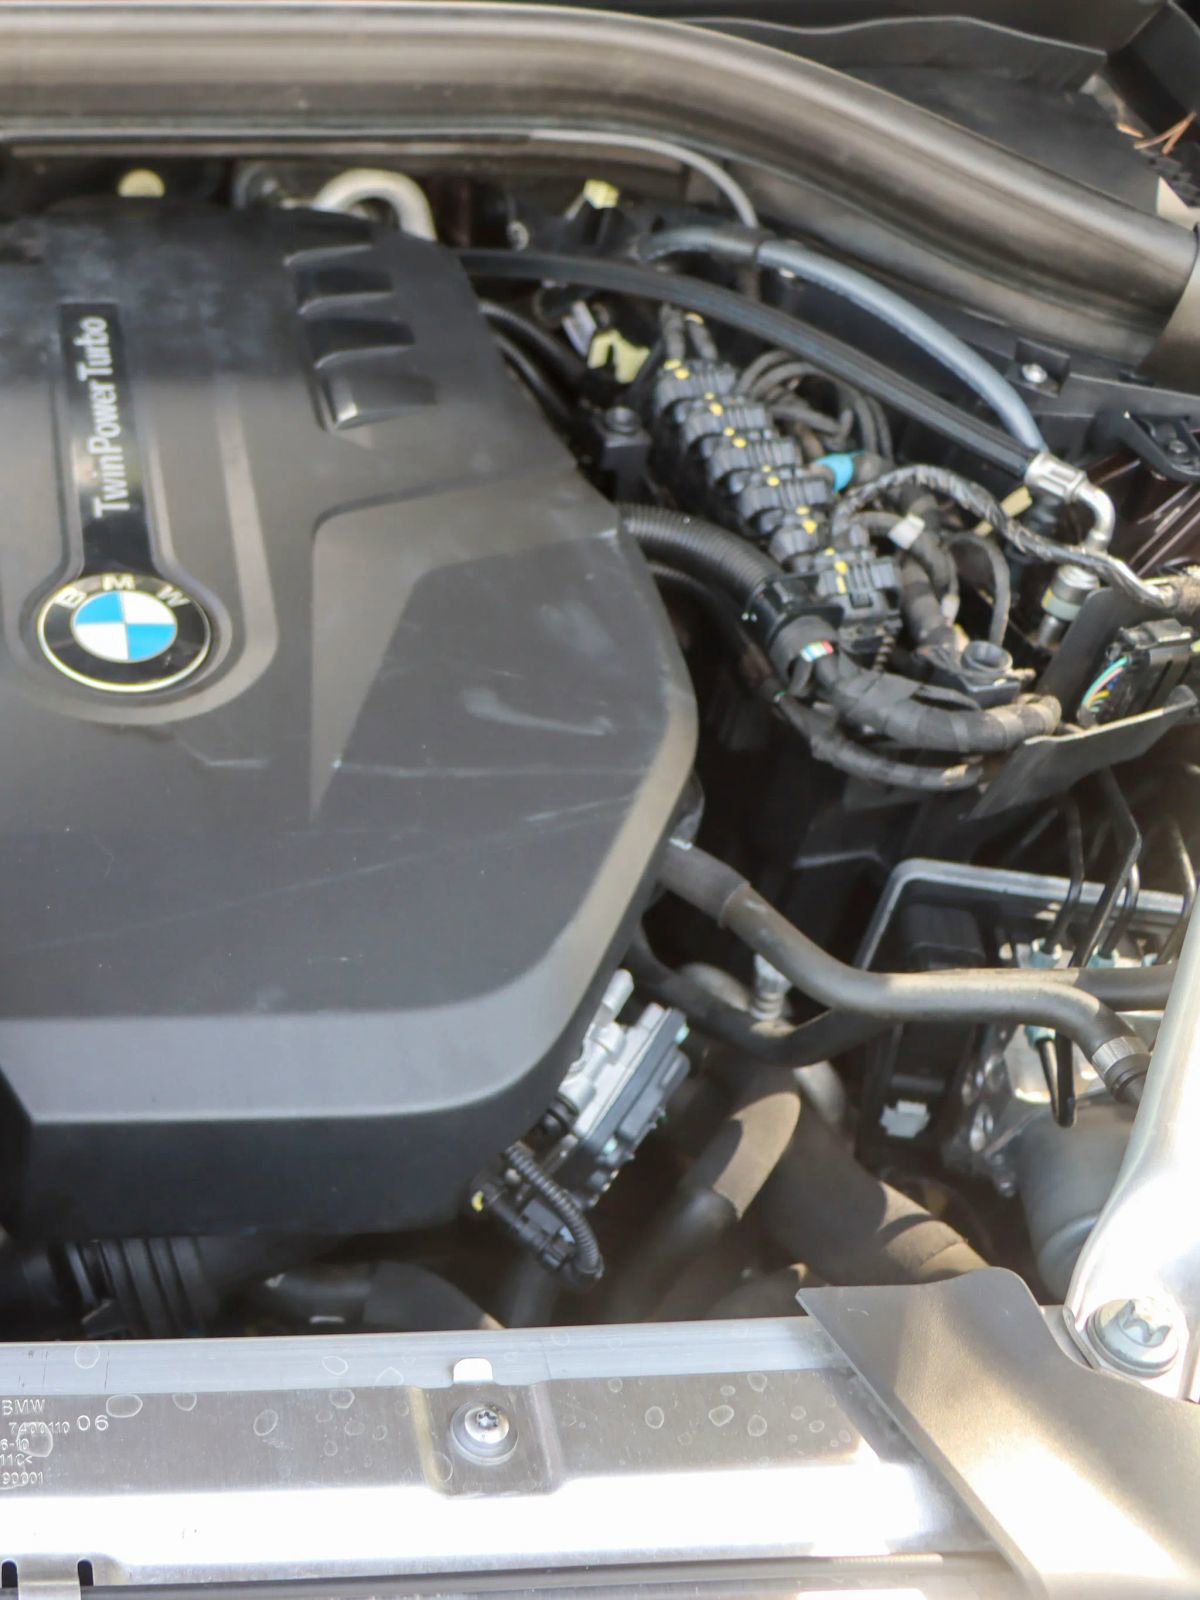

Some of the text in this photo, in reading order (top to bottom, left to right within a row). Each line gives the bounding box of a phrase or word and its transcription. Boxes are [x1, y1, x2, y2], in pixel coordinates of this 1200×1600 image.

[73, 316, 131, 518] TwinPower Turbo
[54, 573, 191, 608] BMW
[1, 1399, 45, 1416] BMW
